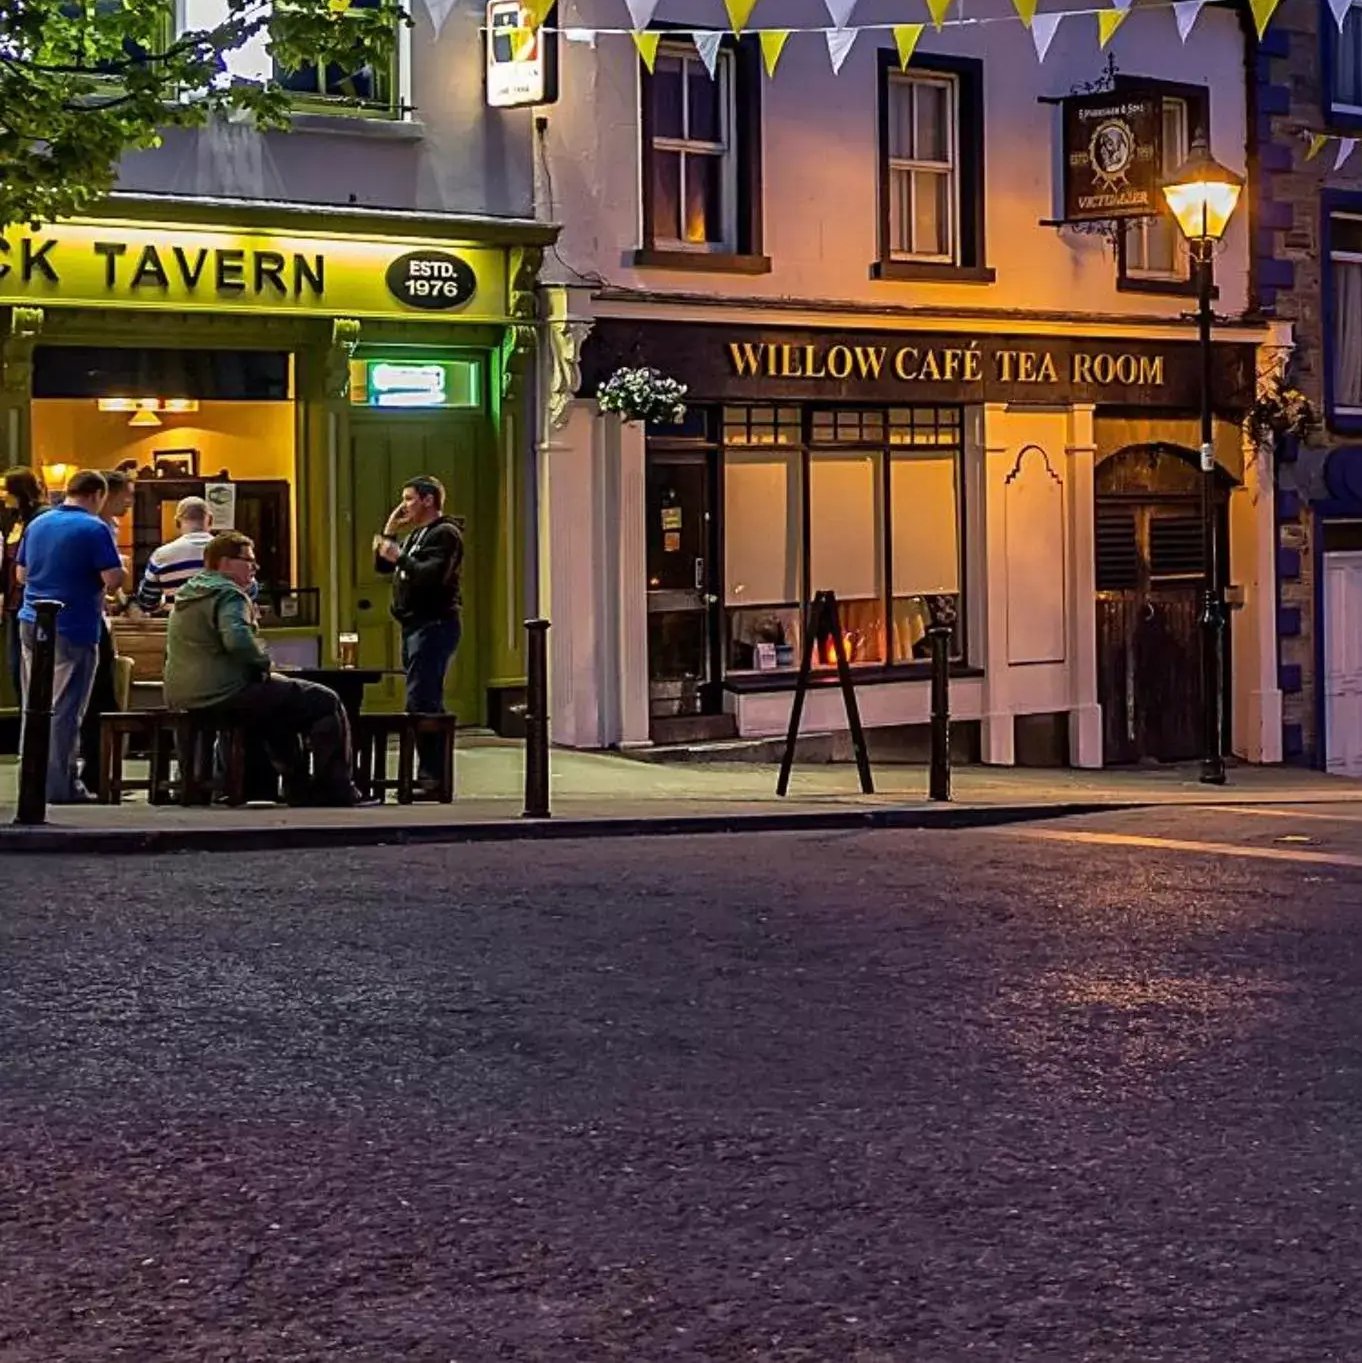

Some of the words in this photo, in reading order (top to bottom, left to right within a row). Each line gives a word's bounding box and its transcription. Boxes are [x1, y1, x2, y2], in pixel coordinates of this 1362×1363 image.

[94, 242, 325, 295] TAVERN
[409, 259, 458, 278] ESTD.
[404, 279, 459, 297] 1976
[729, 341, 886, 379] WILLOW
[895, 341, 983, 381] CAFÉ
[996, 350, 1059, 383] TEA
[1072, 353, 1165, 386] ROOM
